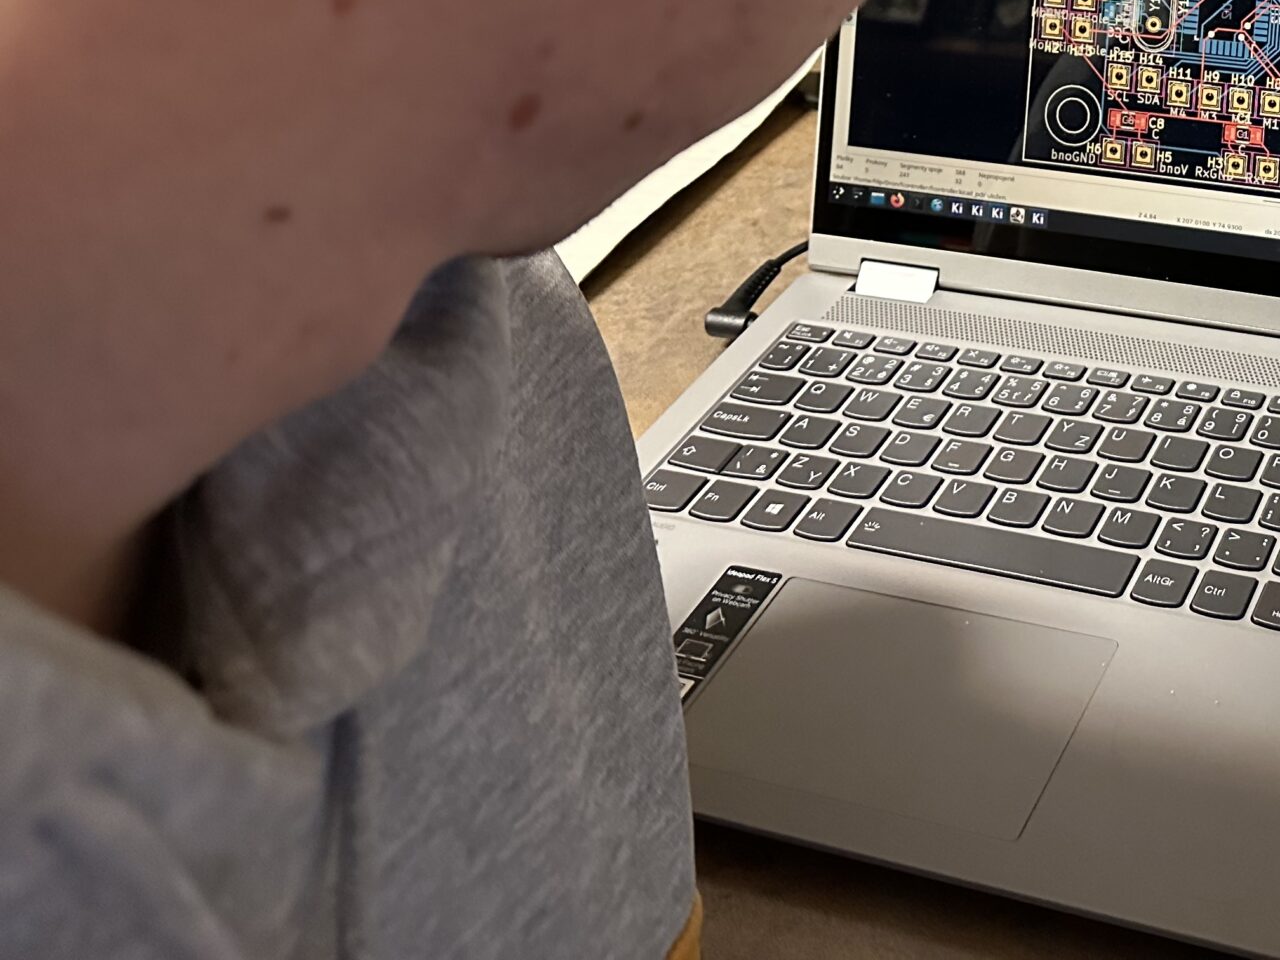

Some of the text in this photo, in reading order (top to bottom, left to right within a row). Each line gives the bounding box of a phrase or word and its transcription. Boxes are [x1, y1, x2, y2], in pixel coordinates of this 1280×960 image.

[1109, 50, 1133, 62] H15
[1139, 53, 1164, 66] H14
[1168, 67, 1193, 79] H11
[1203, 70, 1220, 82] H9
[1231, 74, 1255, 87] H10
[1107, 90, 1129, 103] SCL
[1137, 93, 1160, 106] SDA
[1149, 117, 1165, 129] C8
[1263, 119, 1280, 130] M1
[1086, 142, 1102, 154] H6
[1051, 148, 1096, 164] bnoGND
[1157, 150, 1173, 163] H5
[1207, 156, 1224, 169] H3
[1159, 163, 1189, 176] bnoV
[811, 383, 826, 395] Q
[859, 390, 880, 402] W
[906, 398, 922, 409] E
[713, 410, 750, 423] CapsLk
[956, 406, 972, 417] R
[795, 418, 809, 429] A
[1011, 414, 1023, 425] T
[845, 426, 861, 437] S
[895, 434, 911, 445] D
[646, 481, 667, 492] Ctrl
[705, 492, 720, 501] Fn
[809, 510, 826, 521] Alt
[755, 574, 771, 584] Flex
[1144, 572, 1175, 588] AltGr
[1204, 585, 1226, 598] Ctrl
